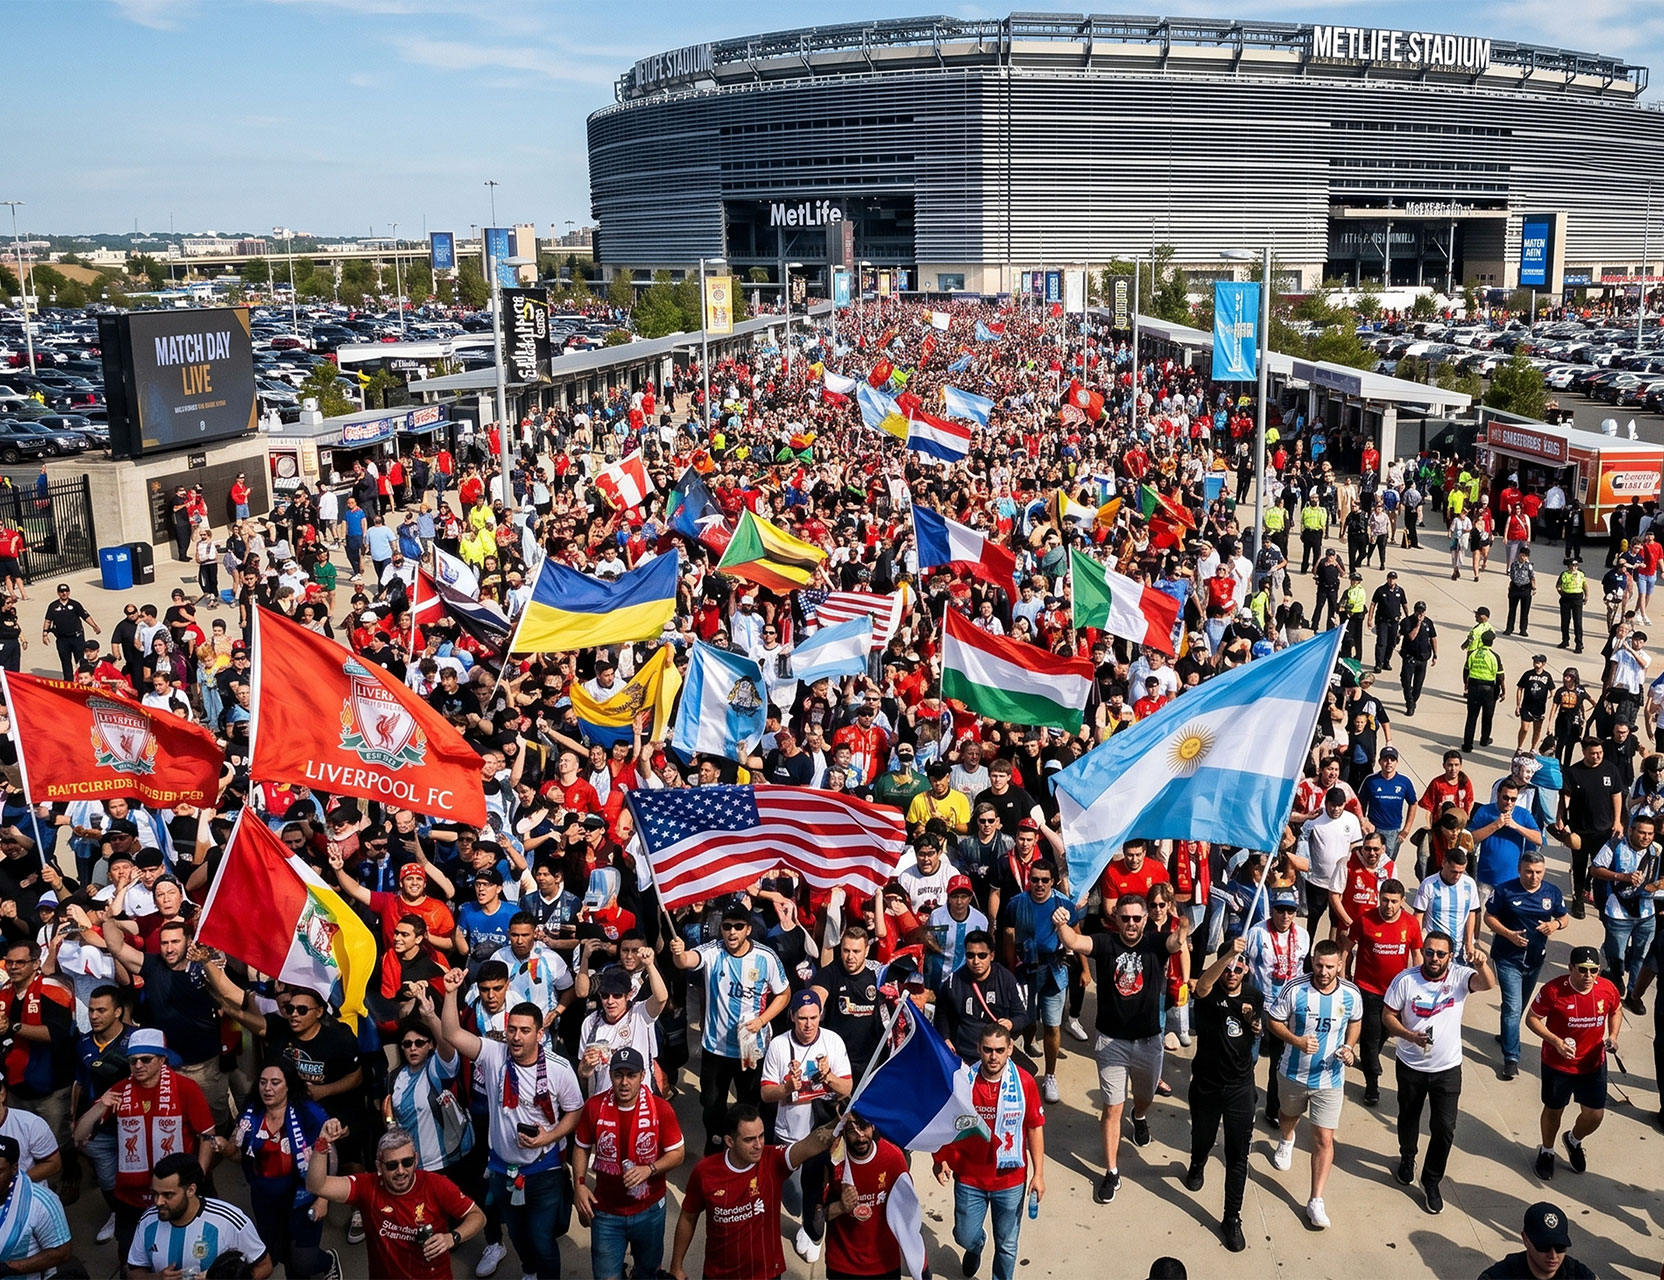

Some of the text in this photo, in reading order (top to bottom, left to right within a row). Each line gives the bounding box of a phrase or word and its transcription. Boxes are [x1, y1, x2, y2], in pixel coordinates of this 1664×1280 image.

[666, 43, 713, 78] STADIUM
[1313, 25, 1491, 69] METLIFE STADIUM
[770, 200, 842, 226] MetLife
[154, 331, 231, 366] MATCH DAY
[182, 364, 212, 396] LIVE
[305, 760, 454, 810] LIVERPOOL FC
